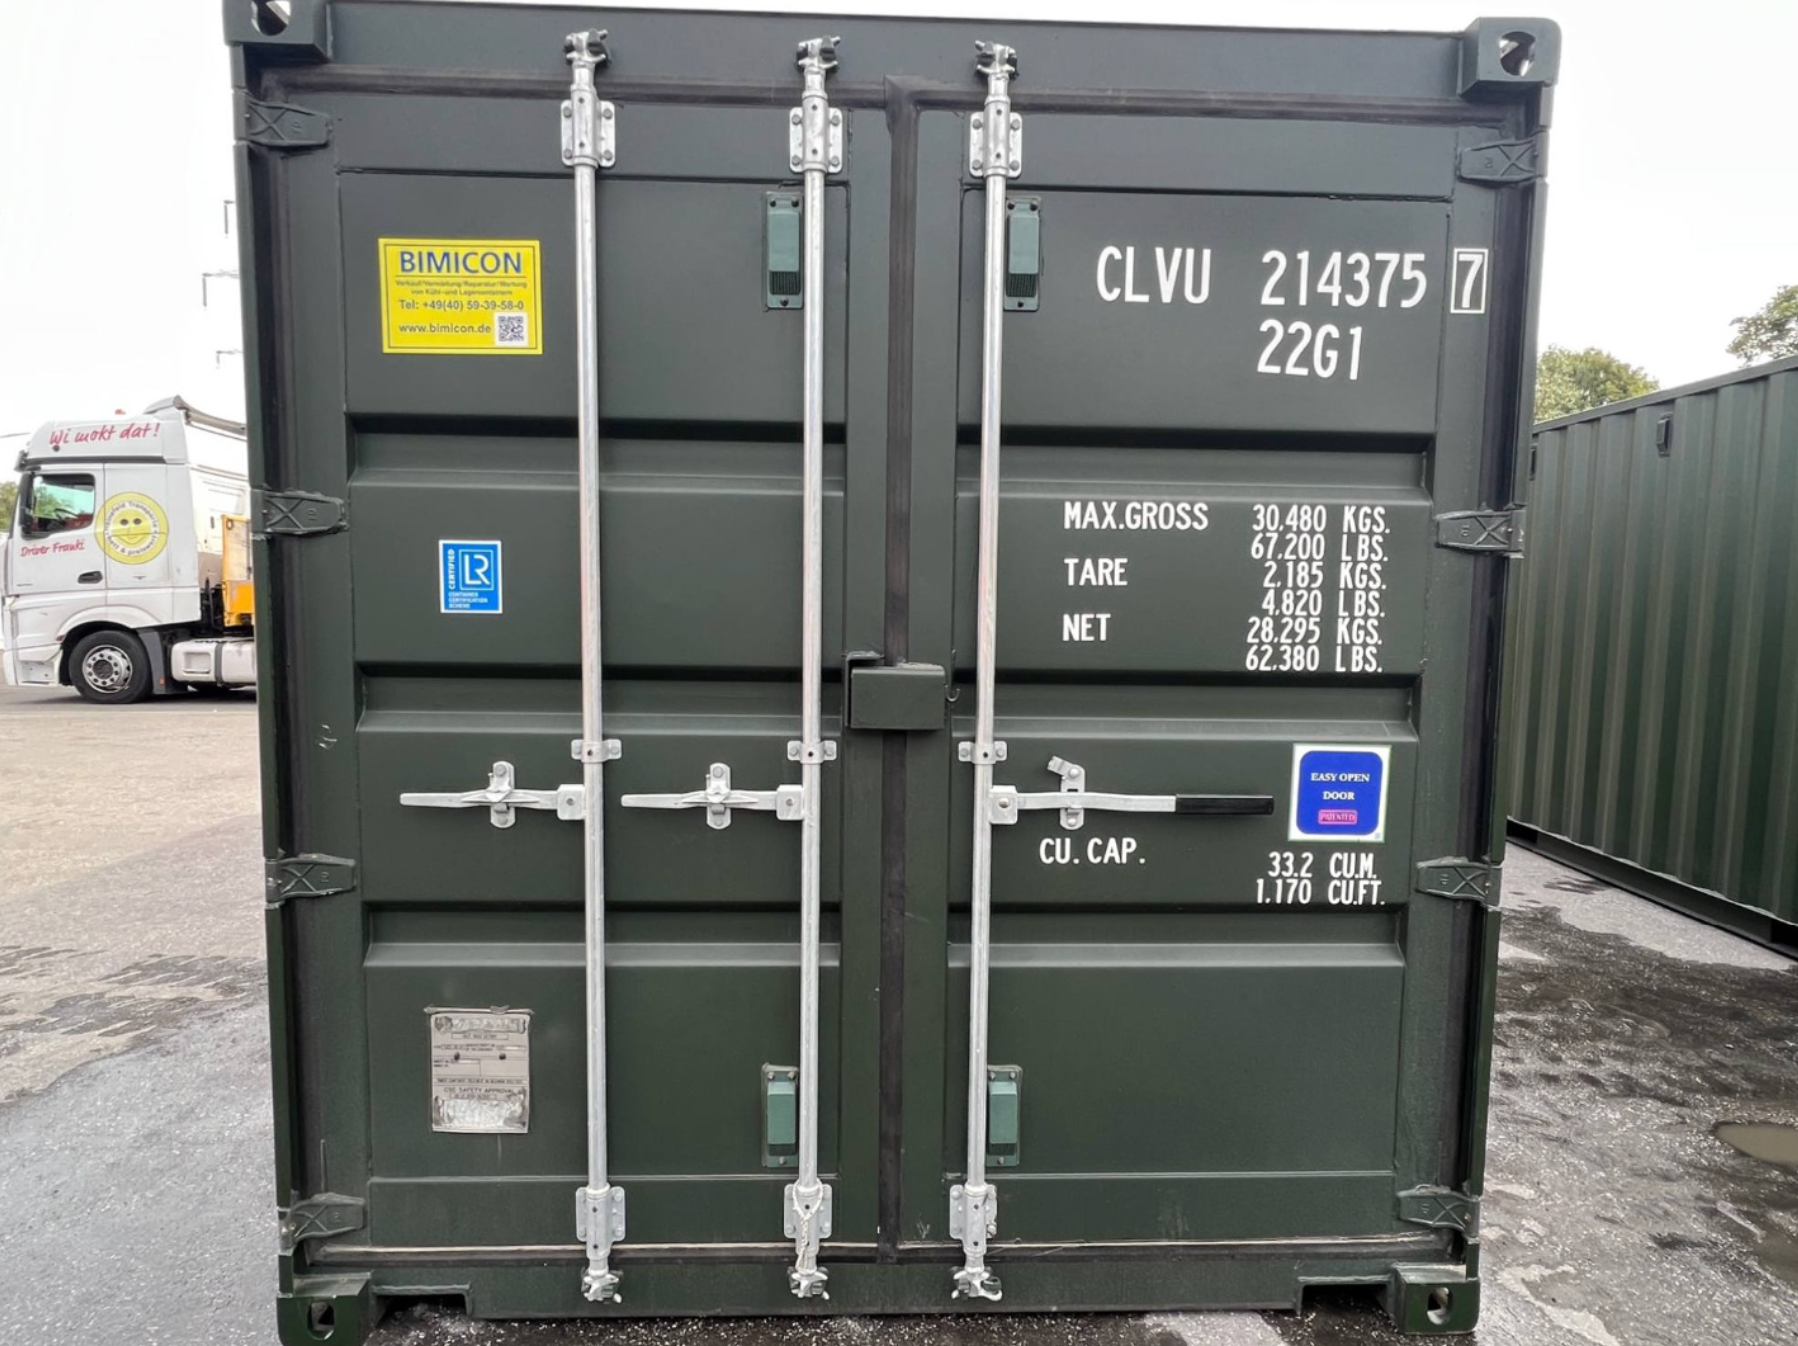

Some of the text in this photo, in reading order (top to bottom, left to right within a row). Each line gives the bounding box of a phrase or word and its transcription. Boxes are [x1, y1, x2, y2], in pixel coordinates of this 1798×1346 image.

[400, 251, 521, 273] BIMICON
[1097, 246, 1483, 308] CLVU 214375 7
[399, 300, 524, 312] Tel: +49(40) 59-39-58-0
[399, 323, 491, 333] www.bimicon.de
[1258, 319, 1362, 380] 22G1
[49, 428, 72, 444] Wi
[75, 425, 116, 442] mokt
[1064, 501, 1390, 534] MAX.GROSS 30,480 KGS.
[1251, 532, 1388, 562] 67,200 LBS.
[464, 554, 491, 585] LR
[1064, 558, 1386, 590] TARE 2,185 KGS.
[1262, 589, 1385, 617] 4,820 LBS.
[1063, 613, 1382, 645] NET 28,295 KGS.
[1246, 645, 1382, 672] 62,380 LBS.
[1311, 772, 1370, 782] EASY OPEN
[1323, 791, 1355, 800] DOOR
[1040, 838, 1145, 864] CU. CAP.
[1268, 852, 1313, 878] 33.2
[1257, 879, 1385, 905] 1,170 CU.FT.
